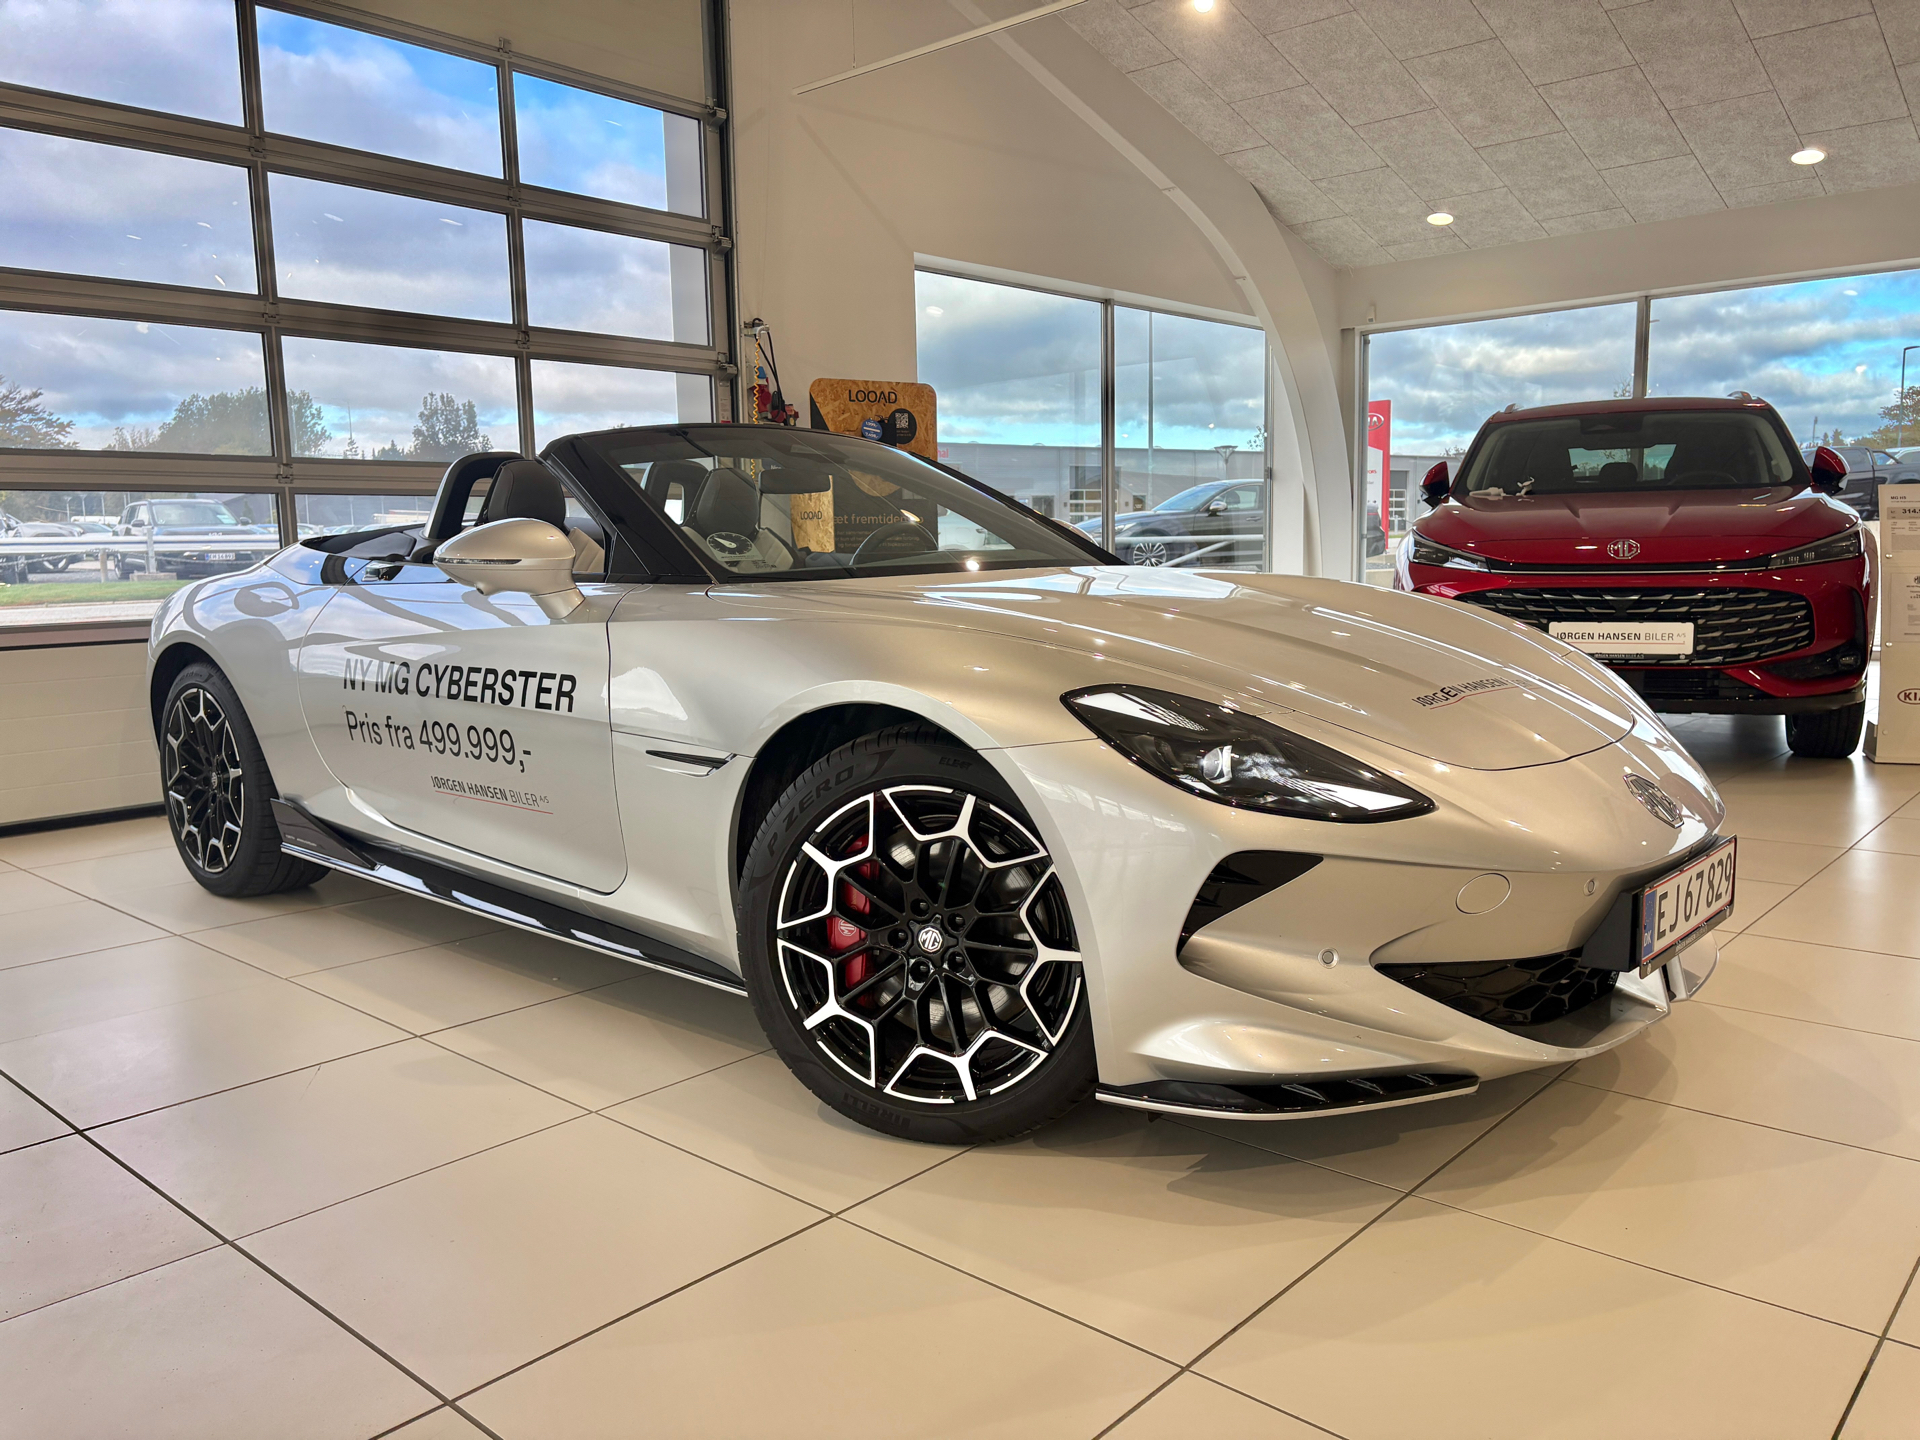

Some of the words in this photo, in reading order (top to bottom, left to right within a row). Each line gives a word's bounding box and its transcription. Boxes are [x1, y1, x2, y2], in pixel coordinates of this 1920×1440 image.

[848, 389, 898, 404] LOOAD
[800, 510, 823, 520] LOOAD
[1608, 540, 1638, 558] MG
[1556, 631, 1595, 640] JØRGEN
[1597, 631, 1641, 641] HANSEN
[1644, 632, 1674, 641] BILER
[343, 658, 374, 690] NY
[375, 661, 411, 695] MG
[416, 663, 577, 712] CYBERSTER
[1411, 685, 1466, 707] JØRGEN
[1459, 677, 1508, 692] HANSEN
[1903, 691, 1920, 701] KI
[345, 710, 383, 746] Pris
[385, 715, 415, 750] fra
[419, 720, 532, 773] 499.999,-
[430, 775, 466, 794] JØRGEN
[467, 782, 508, 802] HANSEN
[509, 789, 540, 808] BILER
[782, 766, 855, 830] ZERO
[920, 929, 942, 951] MG
[1643, 930, 1653, 947] DK
